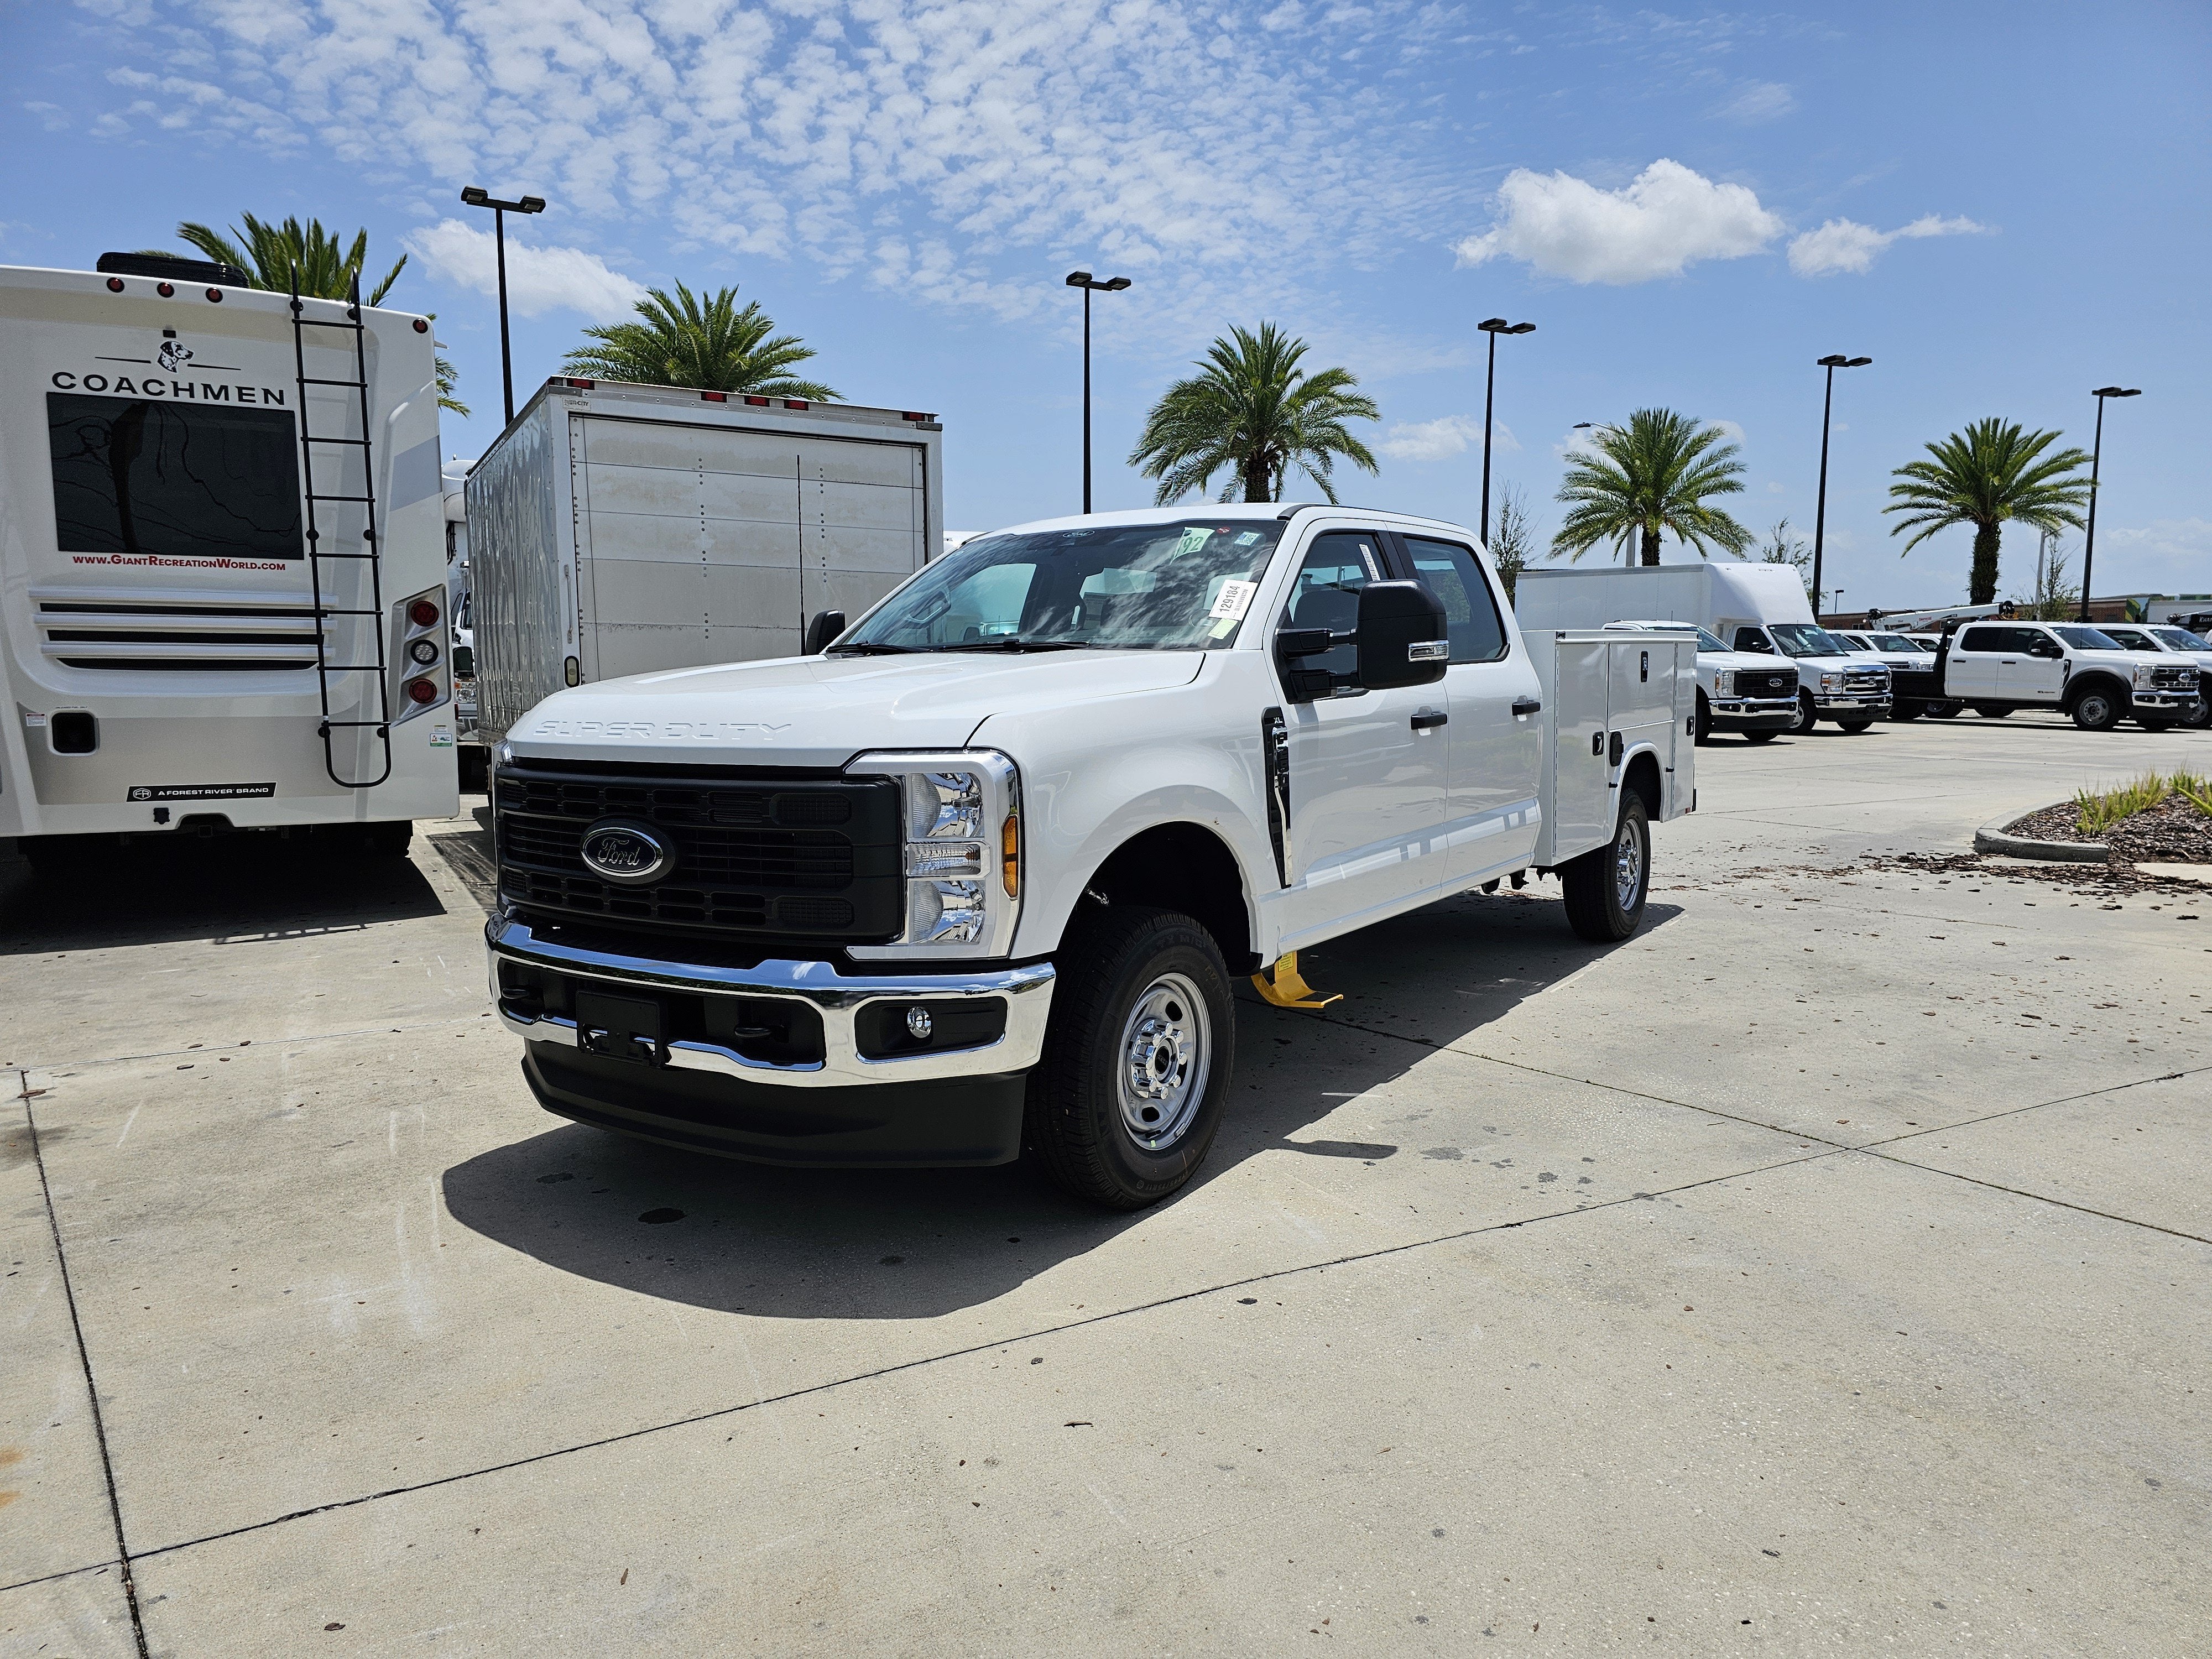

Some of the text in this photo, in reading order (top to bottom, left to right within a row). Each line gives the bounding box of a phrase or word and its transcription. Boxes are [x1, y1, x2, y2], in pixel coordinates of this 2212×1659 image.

[51, 372, 285, 406] COACHMEN
[1219, 586, 1240, 612] 129184
[533, 721, 792, 740] SUPER DUTY
[597, 837, 640, 866] Ford
